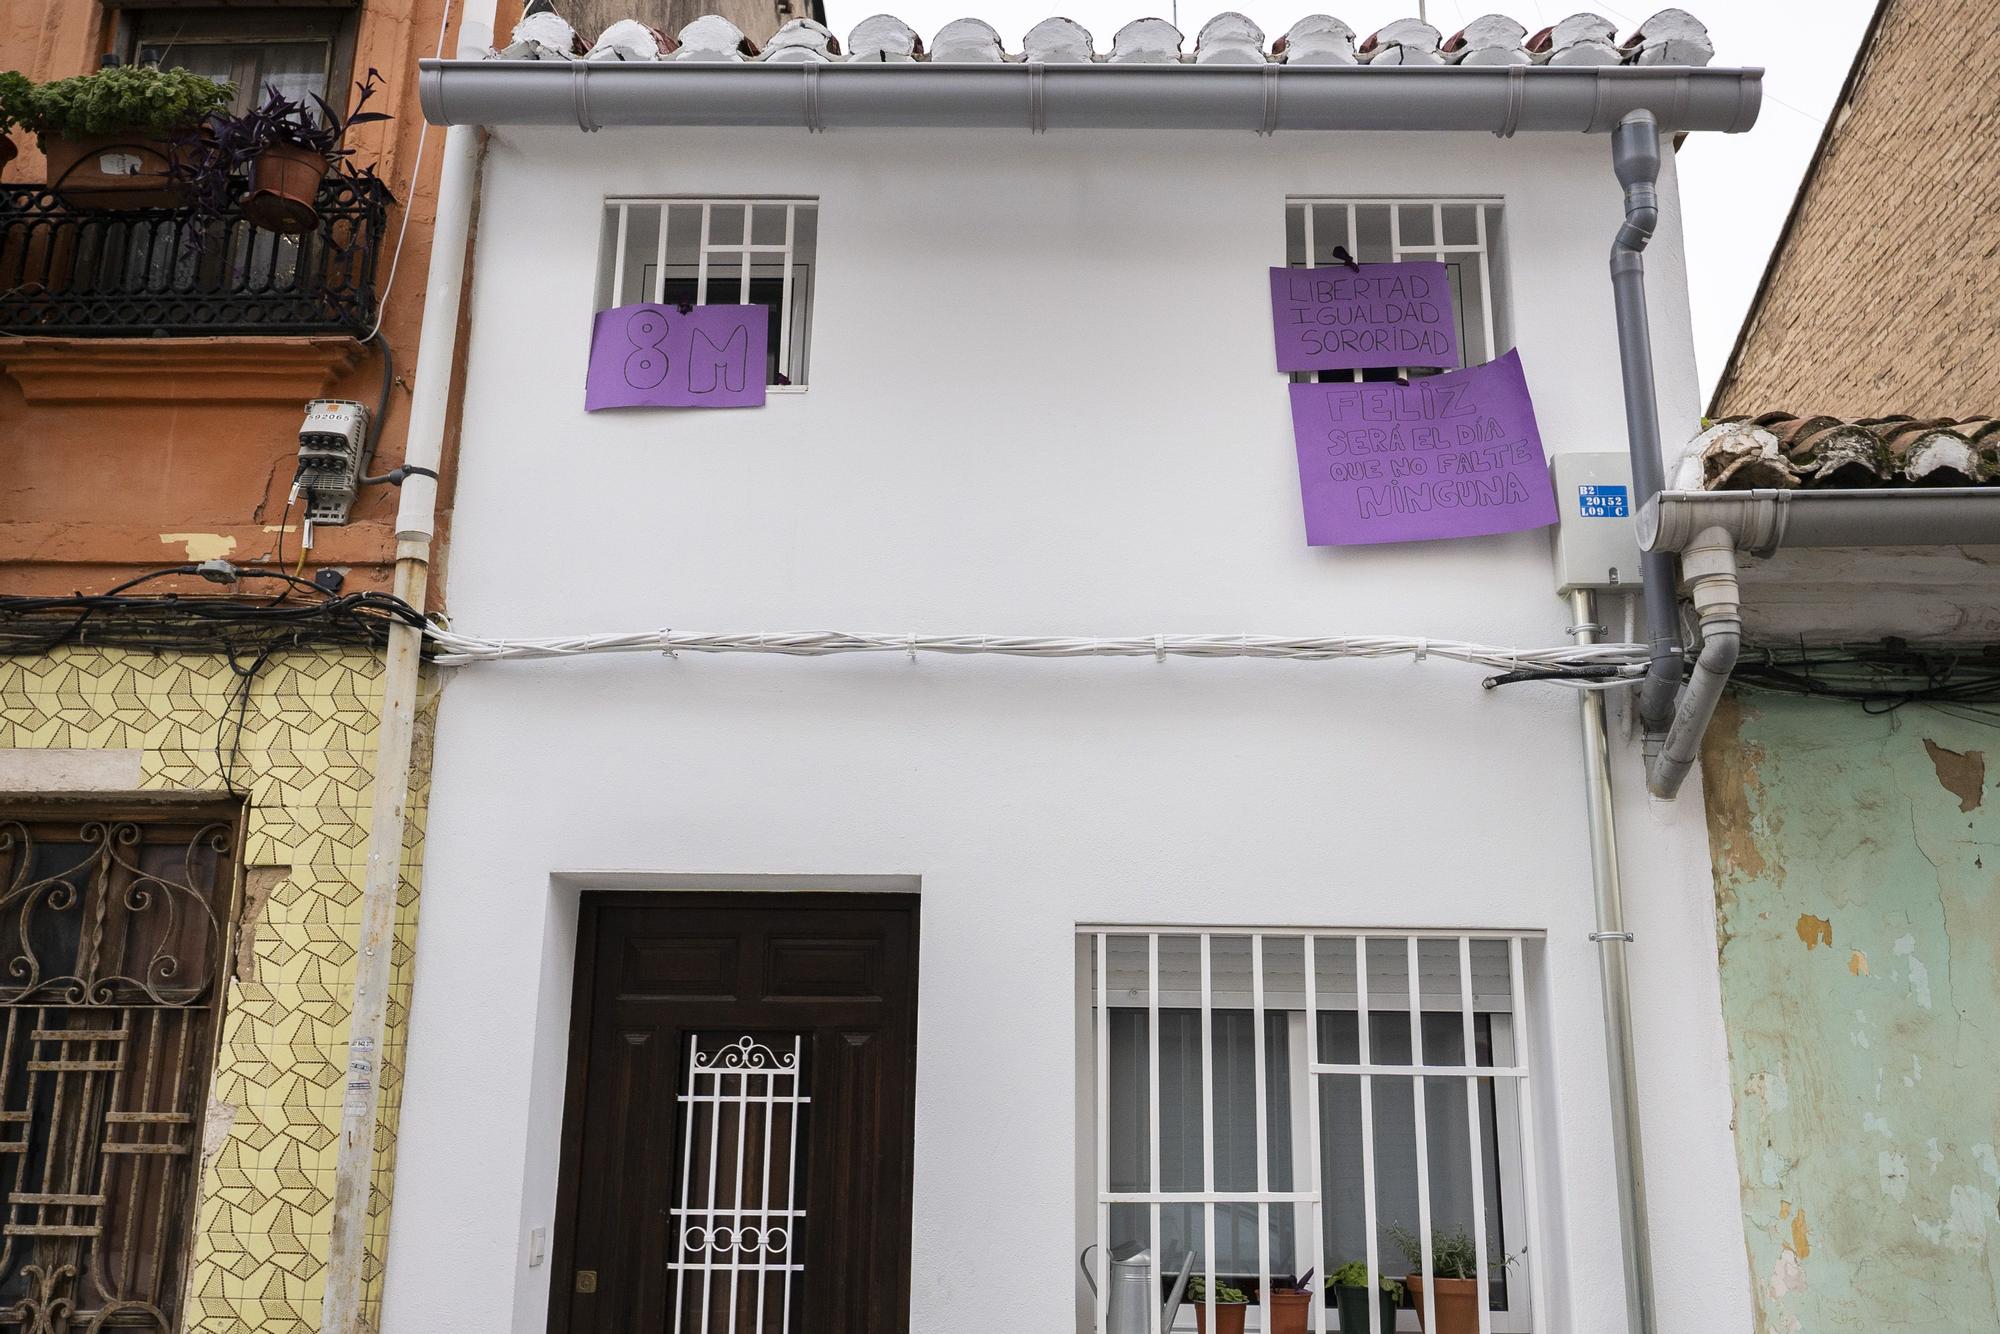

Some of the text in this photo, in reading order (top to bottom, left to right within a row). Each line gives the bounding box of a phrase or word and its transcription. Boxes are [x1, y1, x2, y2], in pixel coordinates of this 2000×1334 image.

[1327, 416, 1505, 456] SERÁ EL DÍA
[1330, 439, 1532, 482] QUE NO FALTE
[1580, 487, 1595, 495] B2
[1586, 497, 1622, 506] 20152
[1581, 507, 1623, 516] L09 C
